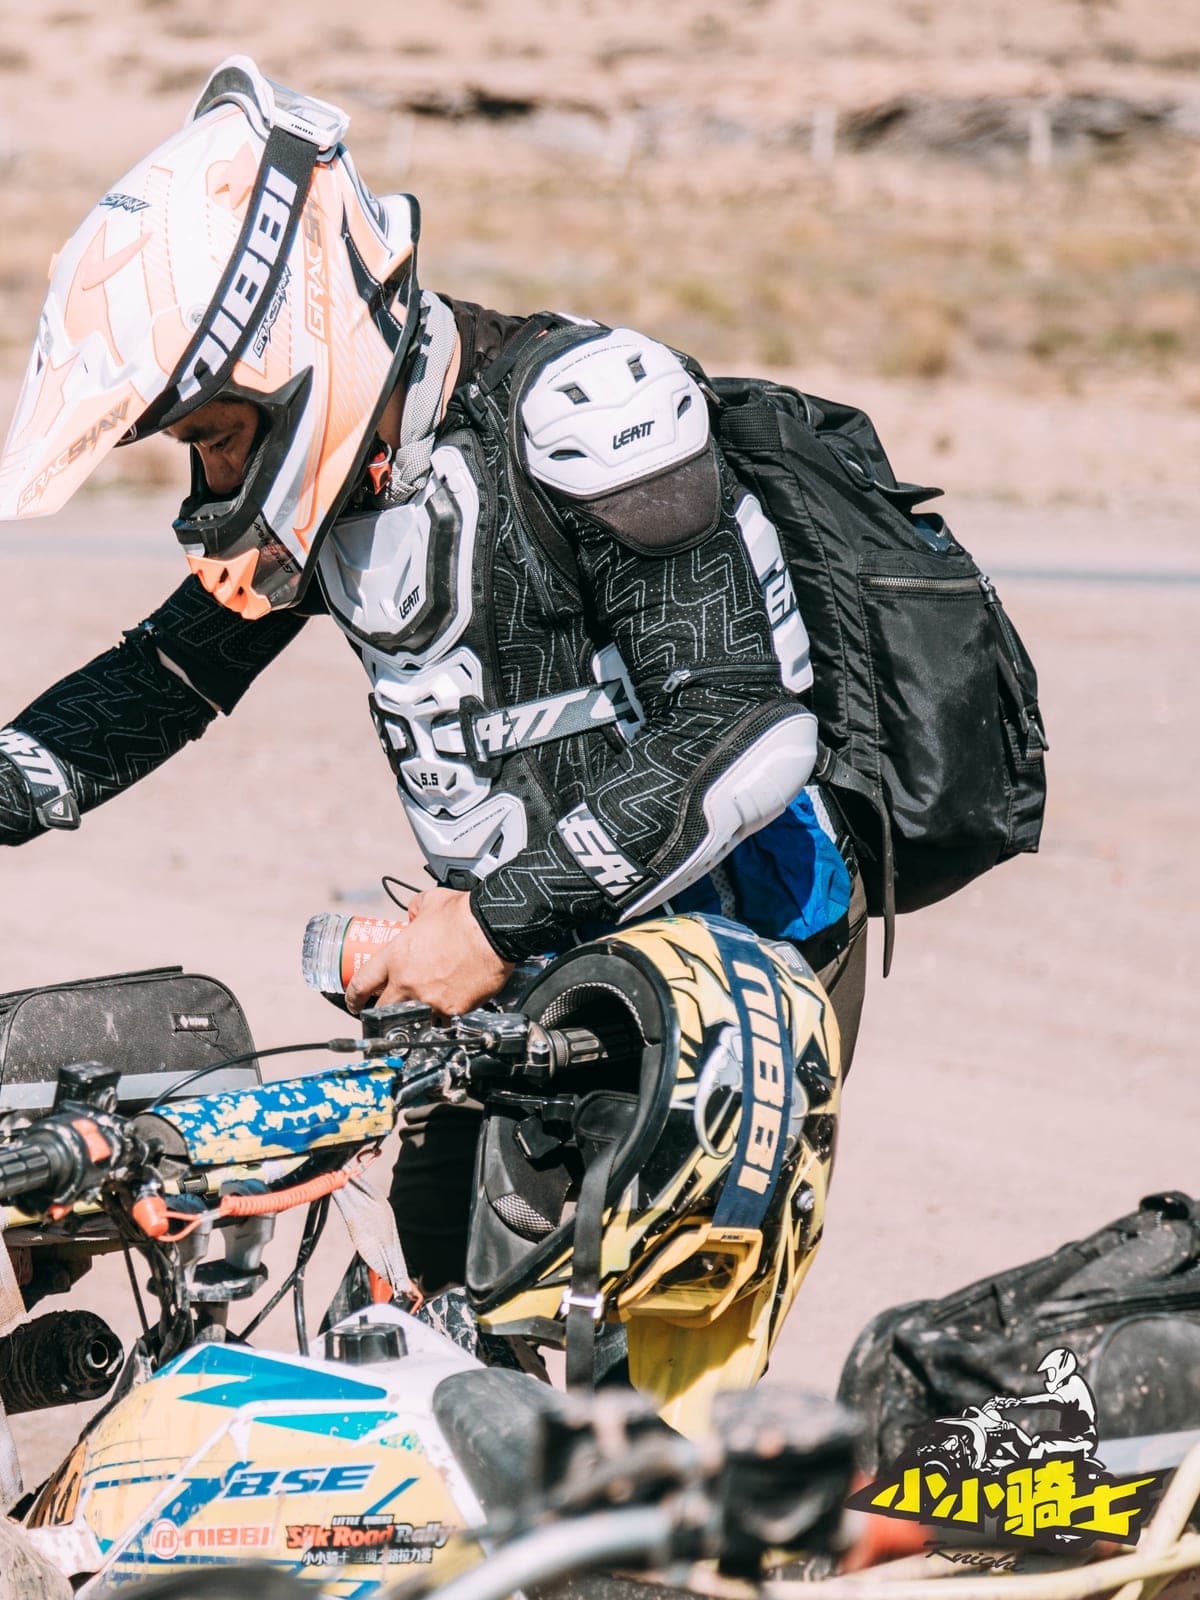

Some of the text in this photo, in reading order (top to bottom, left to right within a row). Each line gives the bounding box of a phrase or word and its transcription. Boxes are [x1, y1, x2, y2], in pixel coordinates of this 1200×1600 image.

[613, 420, 655, 450] LEATT
[399, 584, 420, 620] LEATT
[420, 773, 439, 787] 5.5
